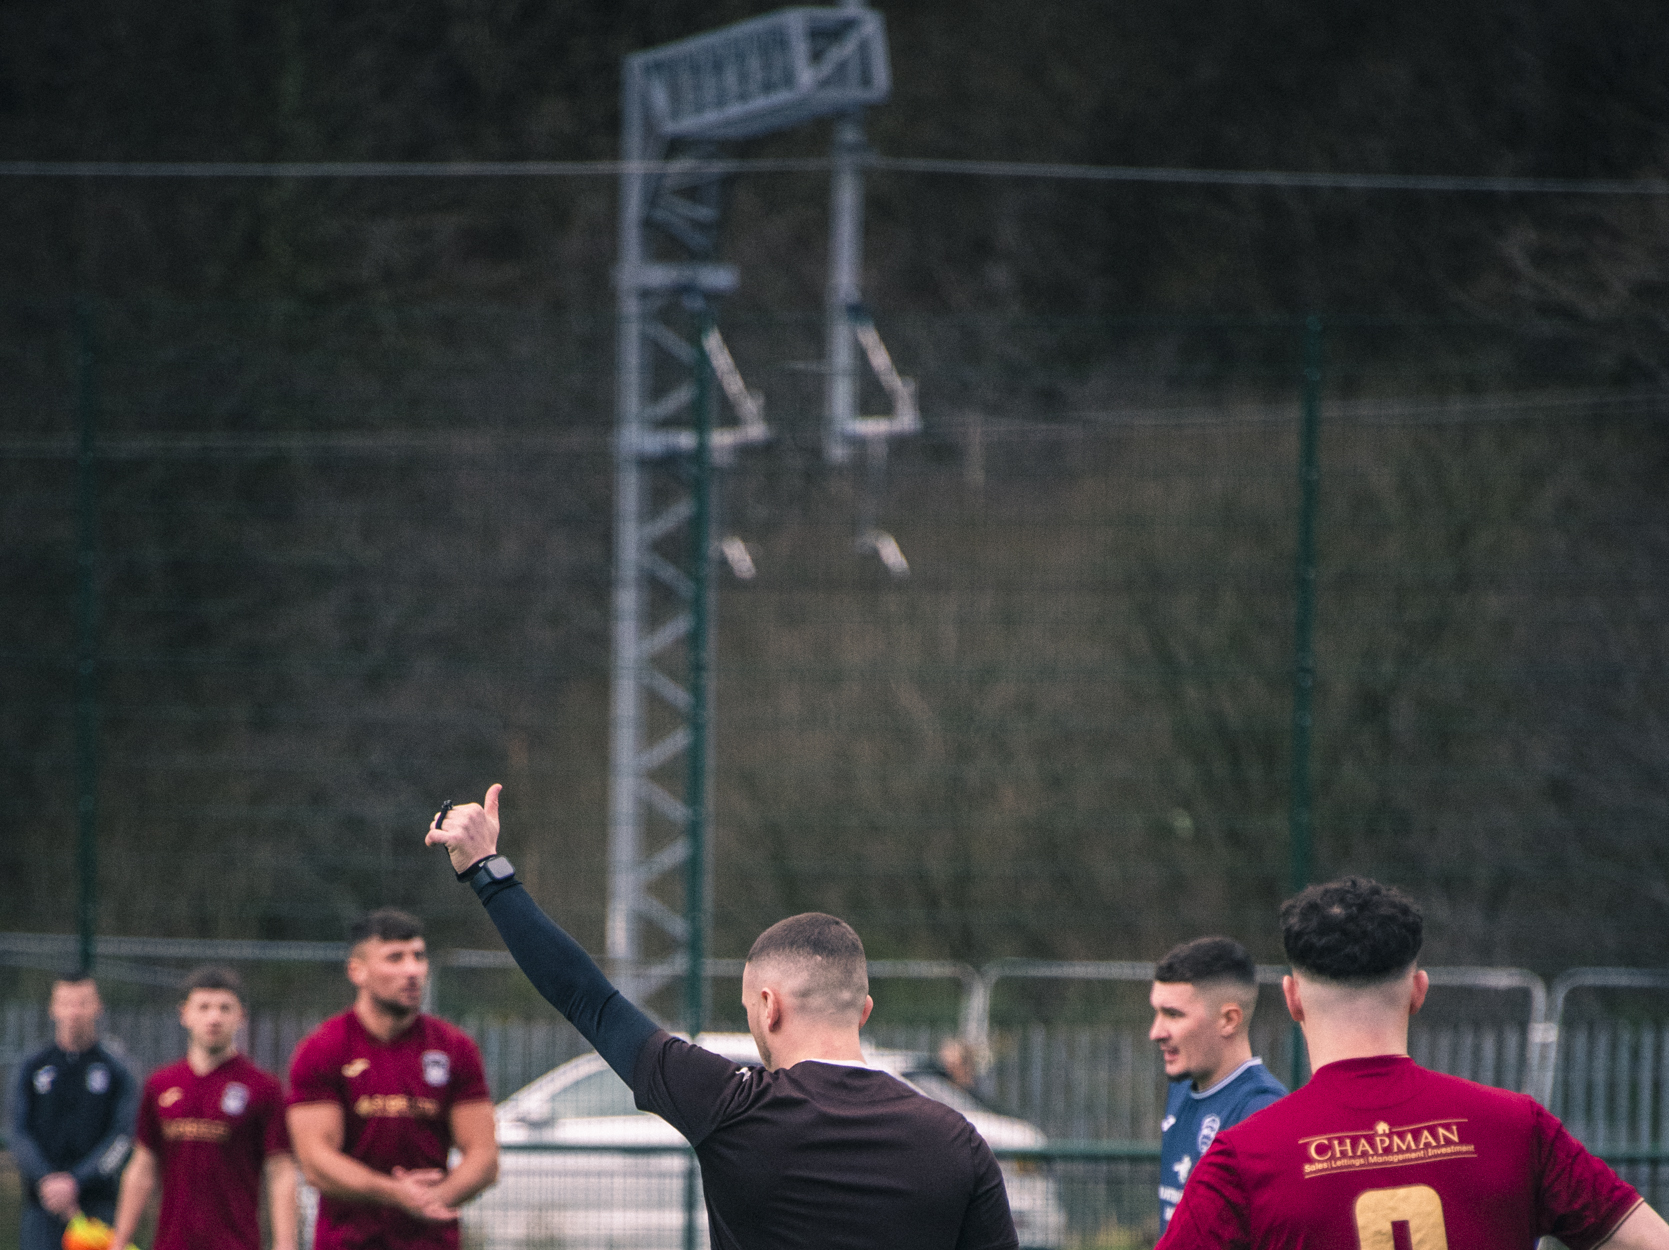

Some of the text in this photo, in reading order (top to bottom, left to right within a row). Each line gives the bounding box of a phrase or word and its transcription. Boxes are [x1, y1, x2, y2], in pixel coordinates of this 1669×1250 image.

[1310, 1125, 1460, 1161] CHAPMAN
[1304, 1162, 1328, 1173] Sales
[1331, 1157, 1365, 1168] Lettings
[1368, 1150, 1424, 1164] Management
